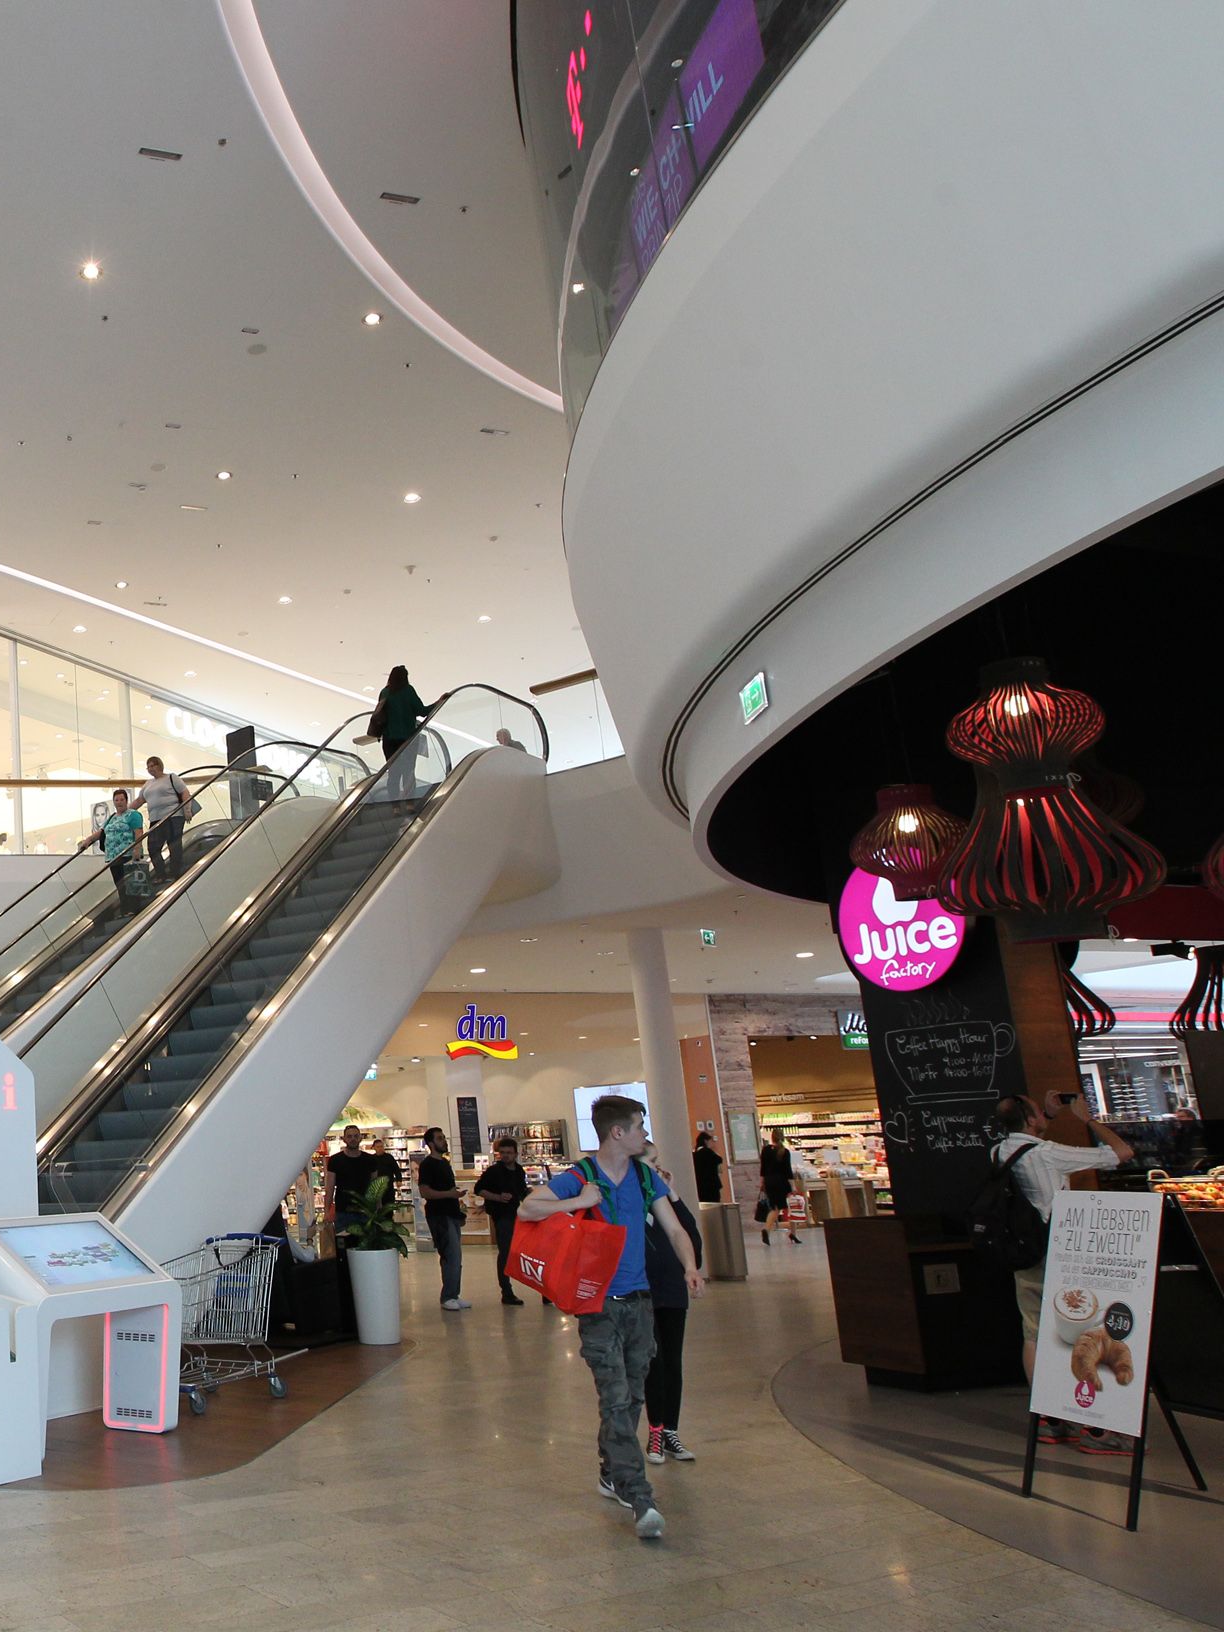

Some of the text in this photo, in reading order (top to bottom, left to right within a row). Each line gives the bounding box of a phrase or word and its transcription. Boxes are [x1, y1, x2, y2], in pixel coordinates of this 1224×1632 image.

[853, 915, 958, 966] Juice
[879, 959, 937, 986] factory
[456, 1003, 508, 1041] dm
[928, 1032, 961, 1054] Happy
